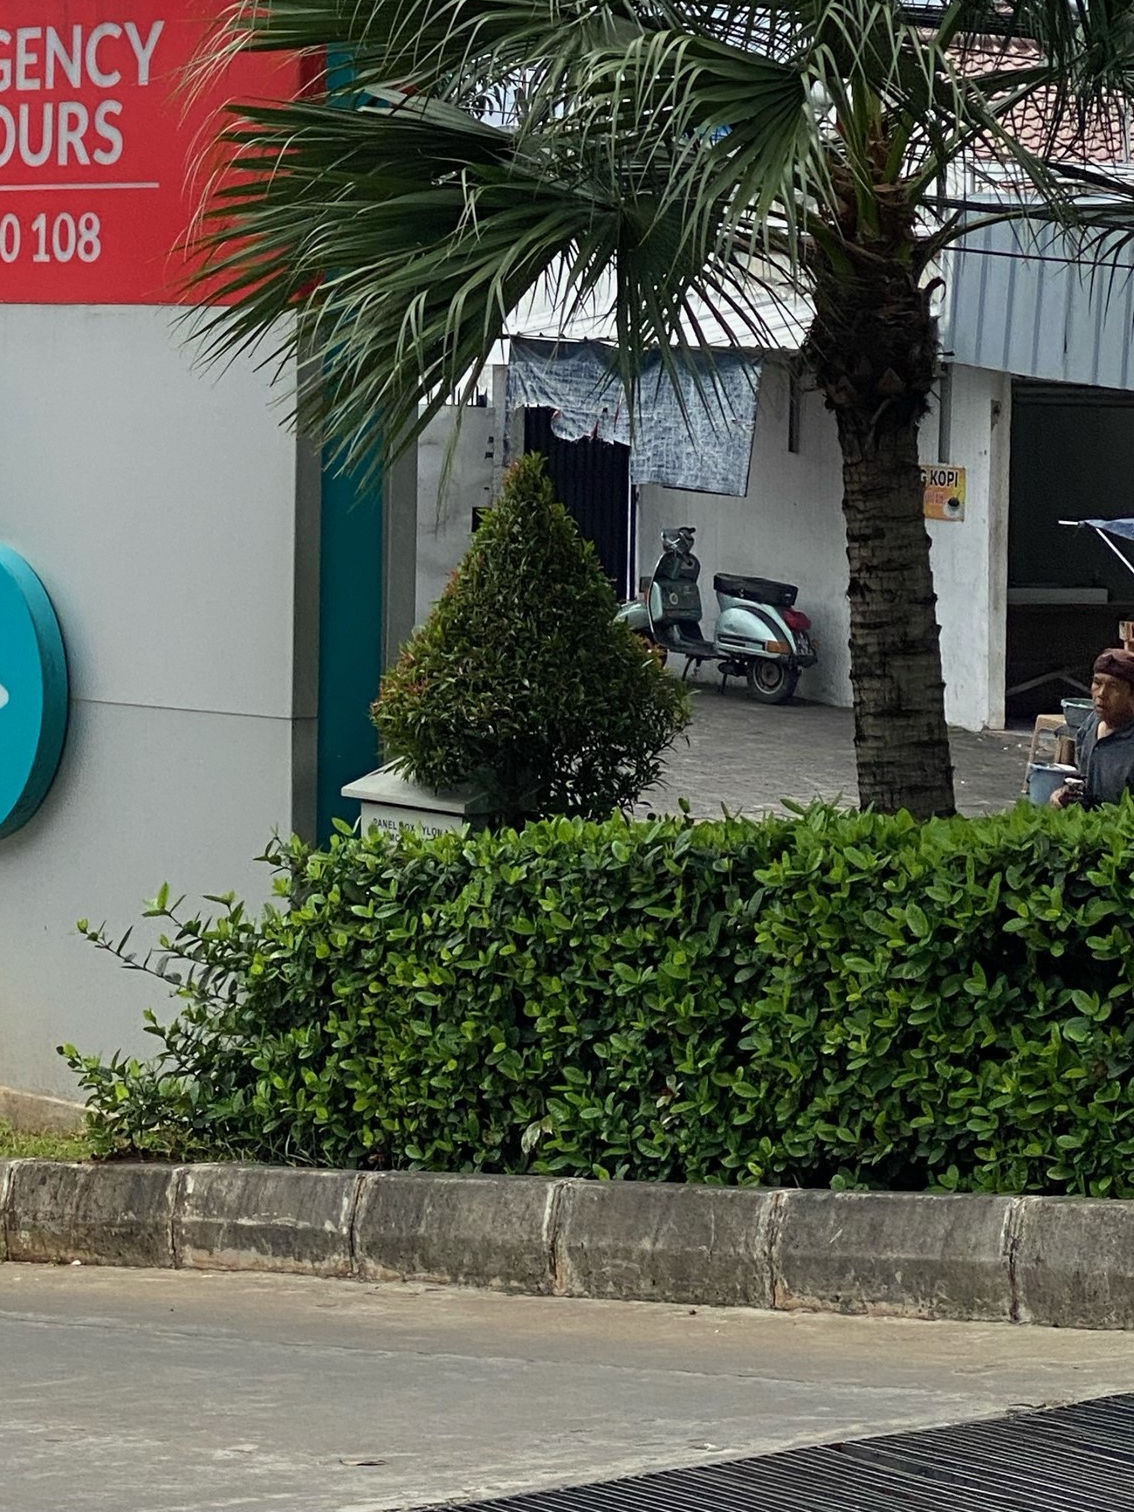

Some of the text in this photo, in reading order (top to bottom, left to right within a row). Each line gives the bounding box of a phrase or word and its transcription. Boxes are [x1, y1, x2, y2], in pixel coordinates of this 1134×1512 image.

[31, 211, 101, 263] 108
[929, 470, 959, 487] KOPI
[373, 818, 397, 831] PANEL
